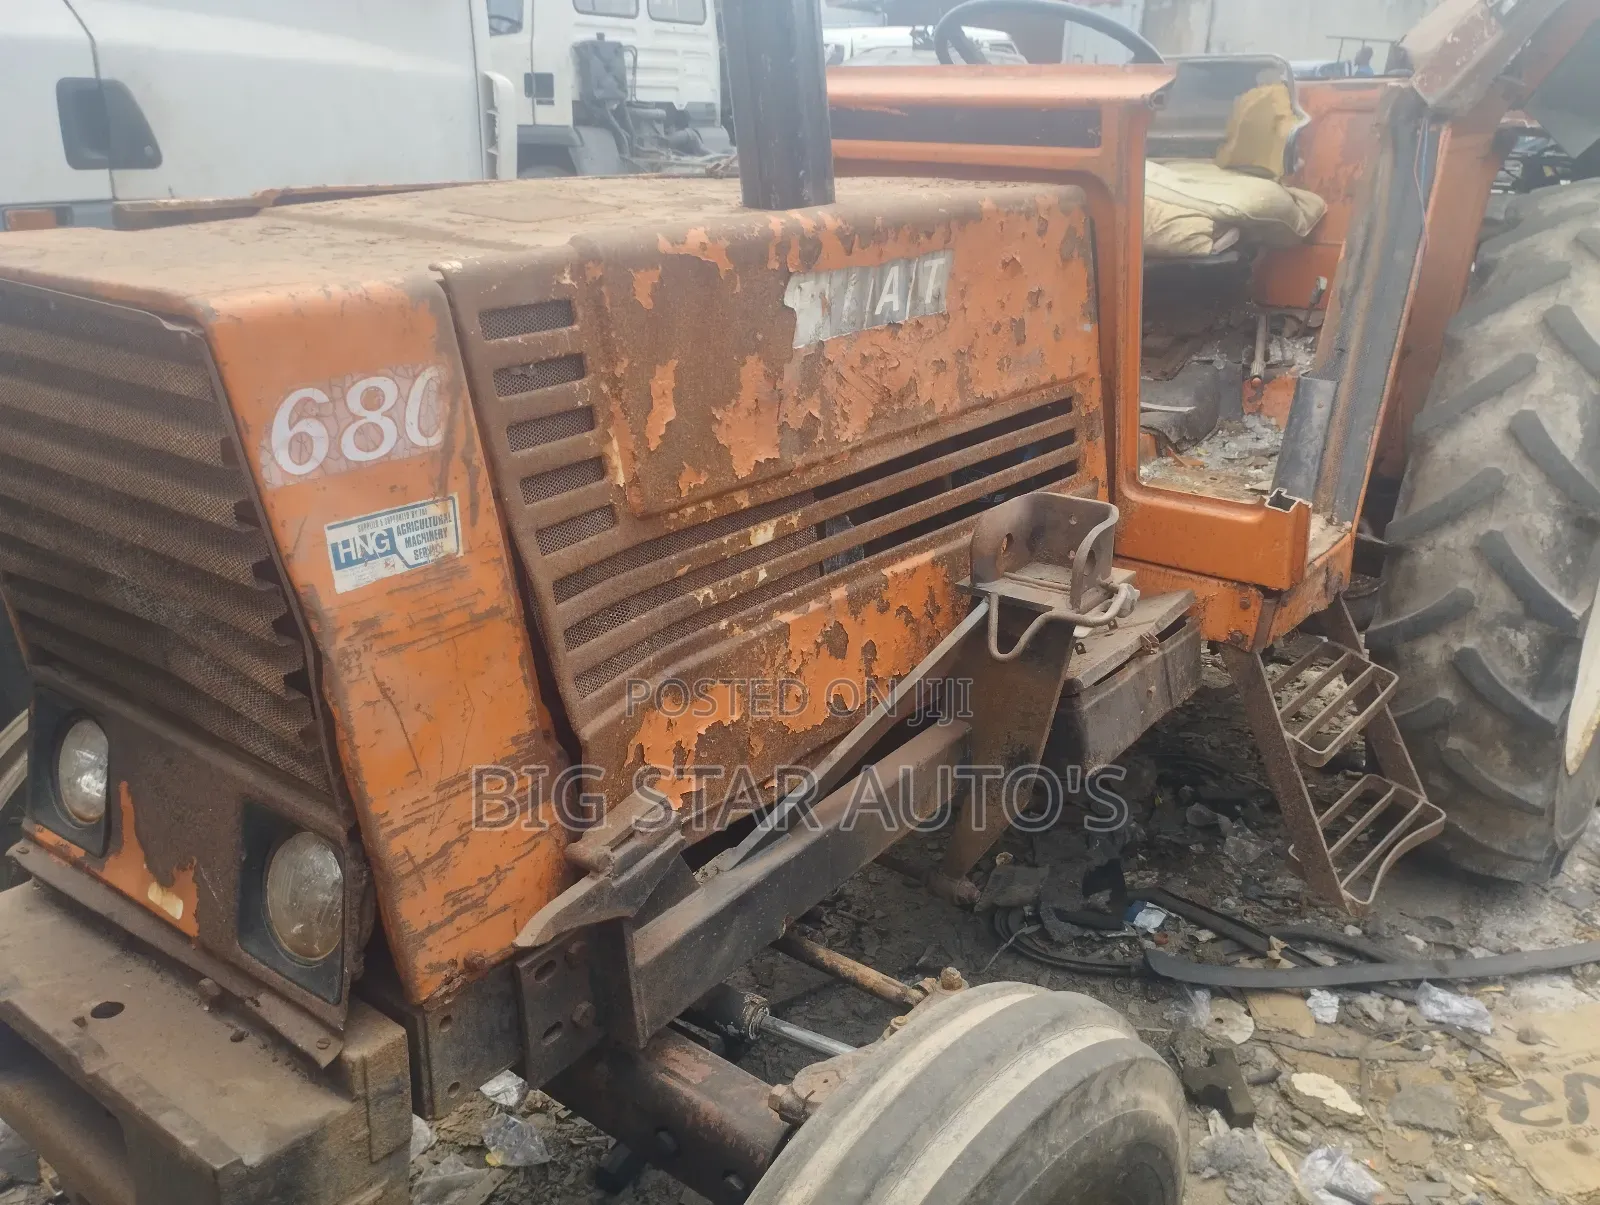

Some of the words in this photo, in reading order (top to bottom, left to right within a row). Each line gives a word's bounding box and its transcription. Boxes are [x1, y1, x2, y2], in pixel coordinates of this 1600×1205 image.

[271, 366, 443, 475] 680
[396, 511, 452, 537] AGRICULTURAL
[404, 527, 448, 549] MACHINERY
[338, 530, 391, 563] HNG
